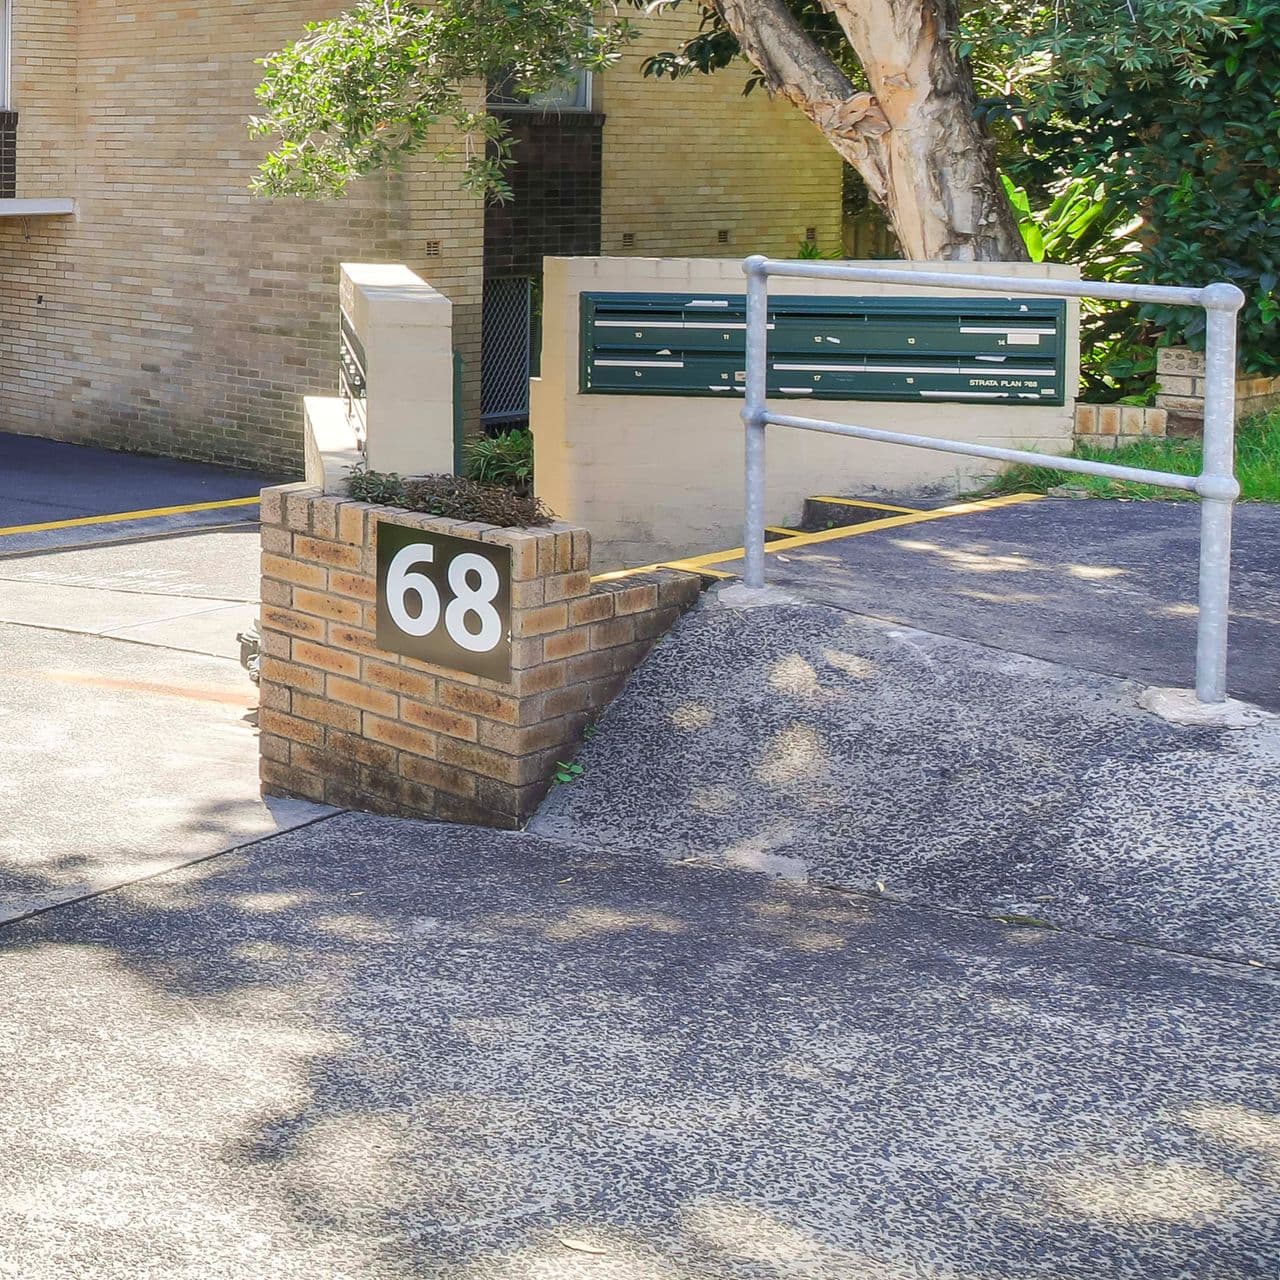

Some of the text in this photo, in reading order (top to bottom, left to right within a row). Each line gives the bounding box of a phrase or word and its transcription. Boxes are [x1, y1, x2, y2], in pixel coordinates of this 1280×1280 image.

[969, 379, 999, 387] STRATA
[1000, 380, 1022, 388] PLAN
[386, 543, 502, 652] 68
